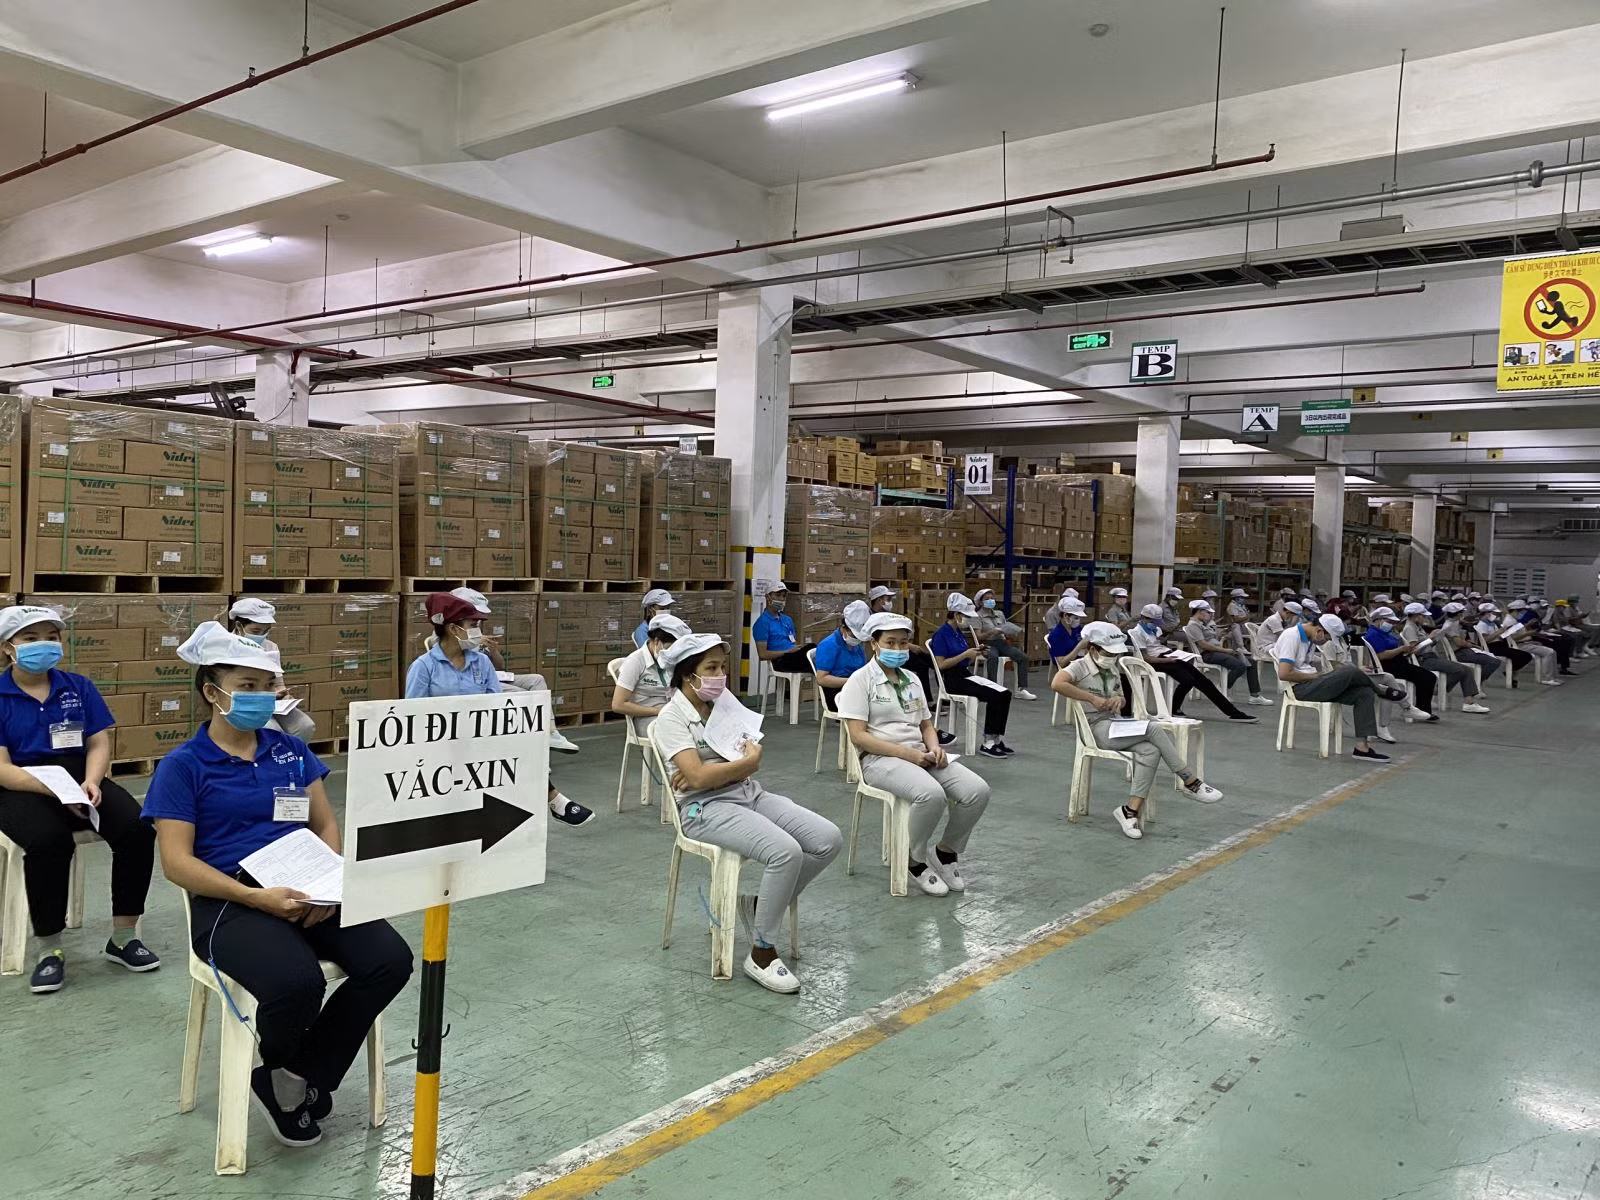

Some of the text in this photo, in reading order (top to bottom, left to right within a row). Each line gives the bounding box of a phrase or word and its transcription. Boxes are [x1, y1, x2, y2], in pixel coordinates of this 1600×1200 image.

[1141, 345, 1170, 354] TEMP
[1132, 353, 1174, 378] B
[1561, 371, 1585, 380] TRÊN
[1587, 370, 1600, 379] HẾ
[1244, 413, 1276, 431] A
[968, 464, 989, 485] 01
[162, 515, 195, 527] Nidec
[76, 545, 113, 555] Nidec
[155, 666, 190, 676] Nidec
[355, 698, 546, 751] LỐI ĐI TIÊM
[155, 730, 190, 740] Nidec
[383, 757, 519, 803] VẮC-XIN
